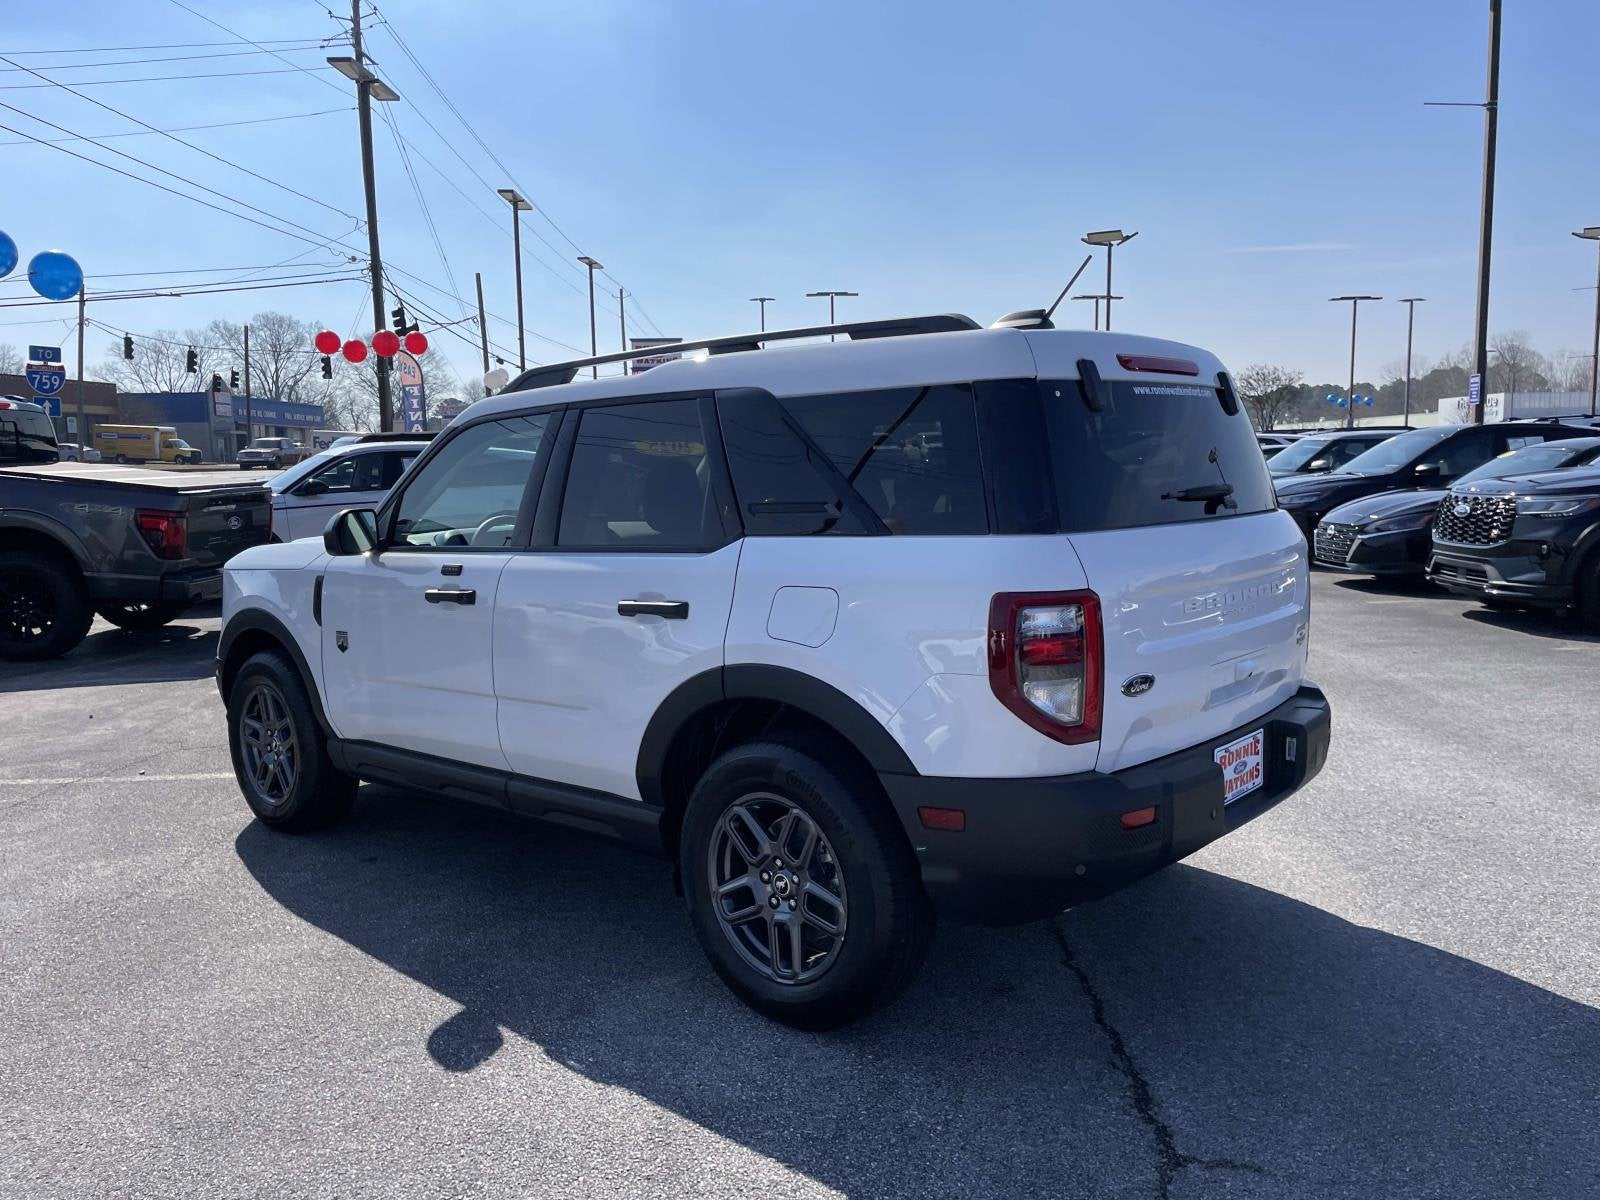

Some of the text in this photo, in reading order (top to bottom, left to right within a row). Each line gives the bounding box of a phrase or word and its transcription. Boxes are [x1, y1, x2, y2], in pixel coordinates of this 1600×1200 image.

[37, 349, 53, 359] TO
[32, 374, 60, 389] 759
[1219, 738, 1261, 770] RONNIE
